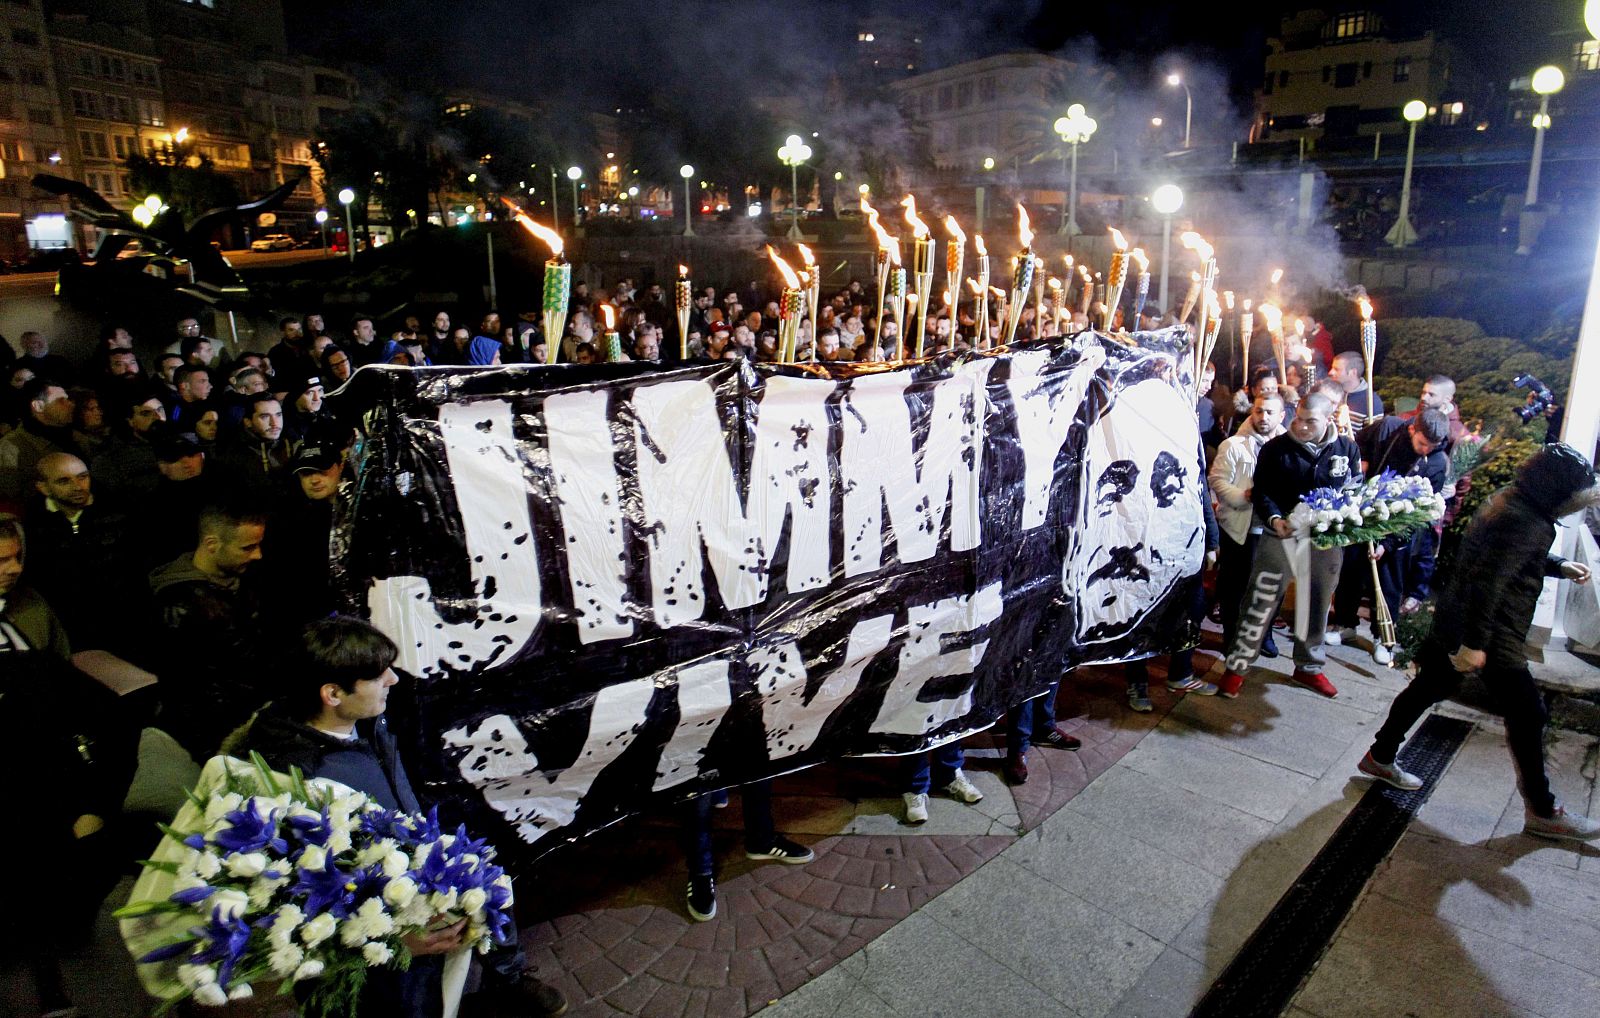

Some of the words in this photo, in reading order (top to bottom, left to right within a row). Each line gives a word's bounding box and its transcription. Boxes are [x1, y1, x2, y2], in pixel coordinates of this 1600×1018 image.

[369, 346, 1105, 680] JIMMY
[1226, 570, 1283, 672] ULTRAS
[441, 582, 1002, 844] VIVE
